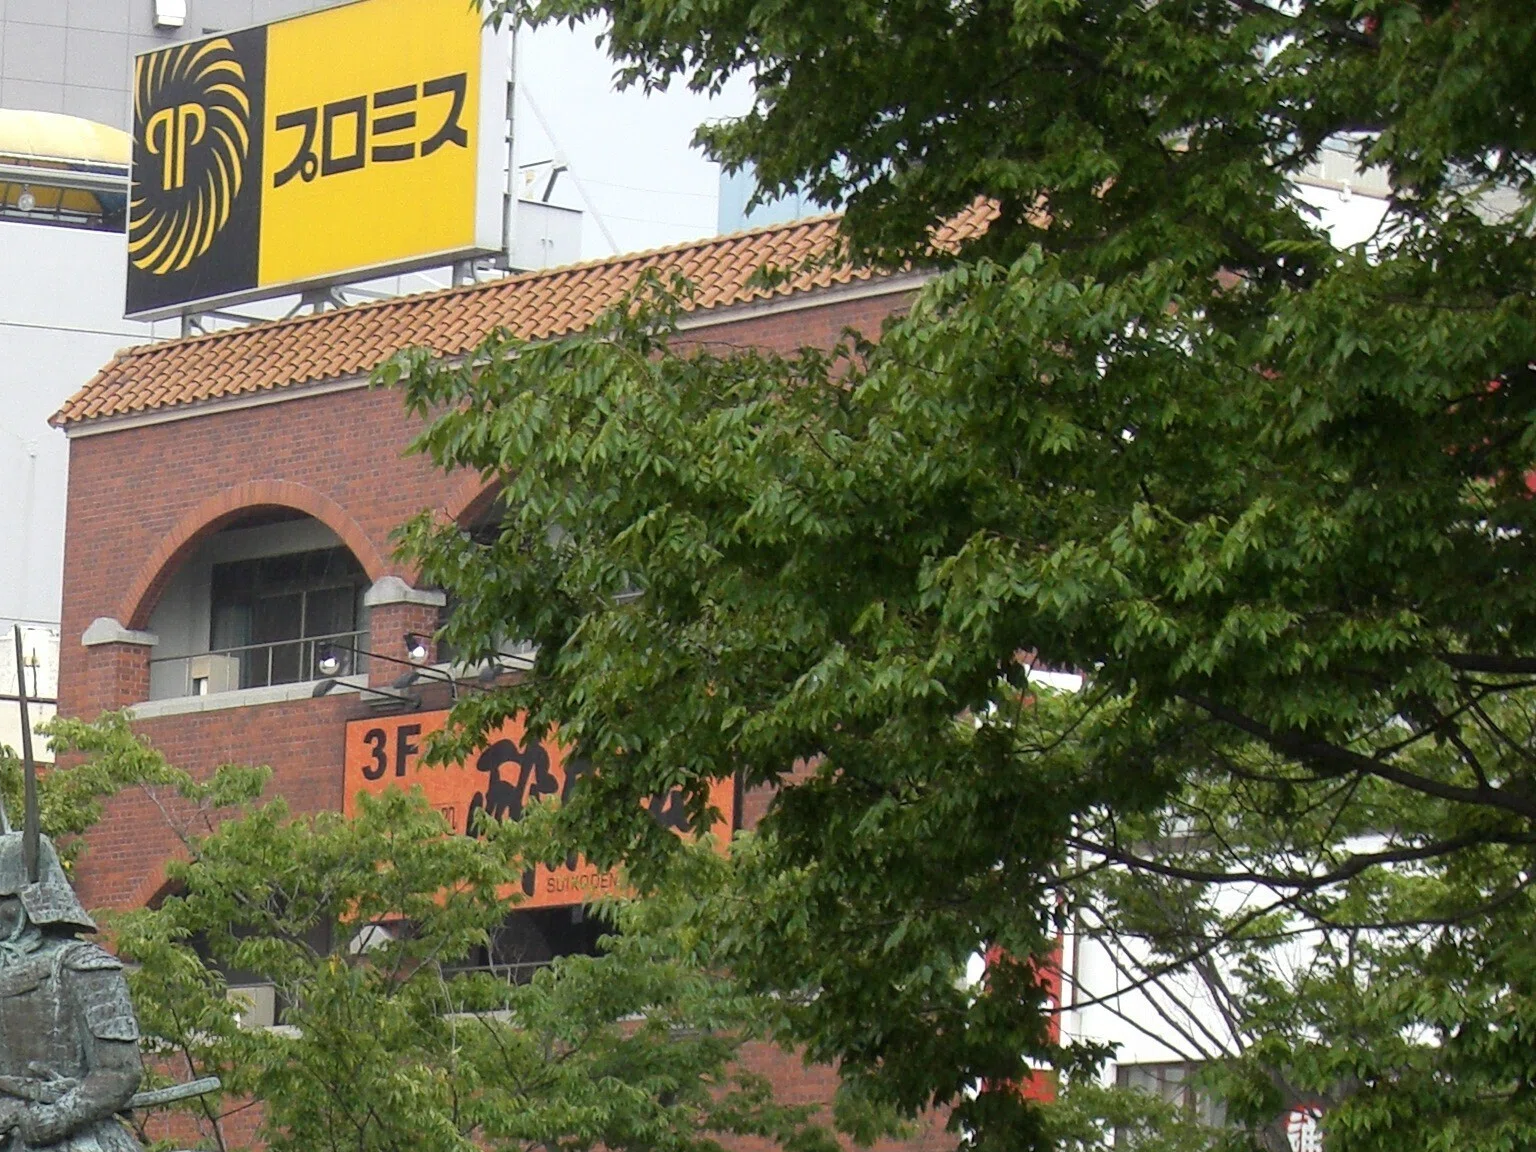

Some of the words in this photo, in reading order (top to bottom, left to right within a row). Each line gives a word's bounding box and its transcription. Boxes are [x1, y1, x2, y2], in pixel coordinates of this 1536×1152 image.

[274, 73, 468, 188] プロミス
[362, 723, 421, 782] 3F
